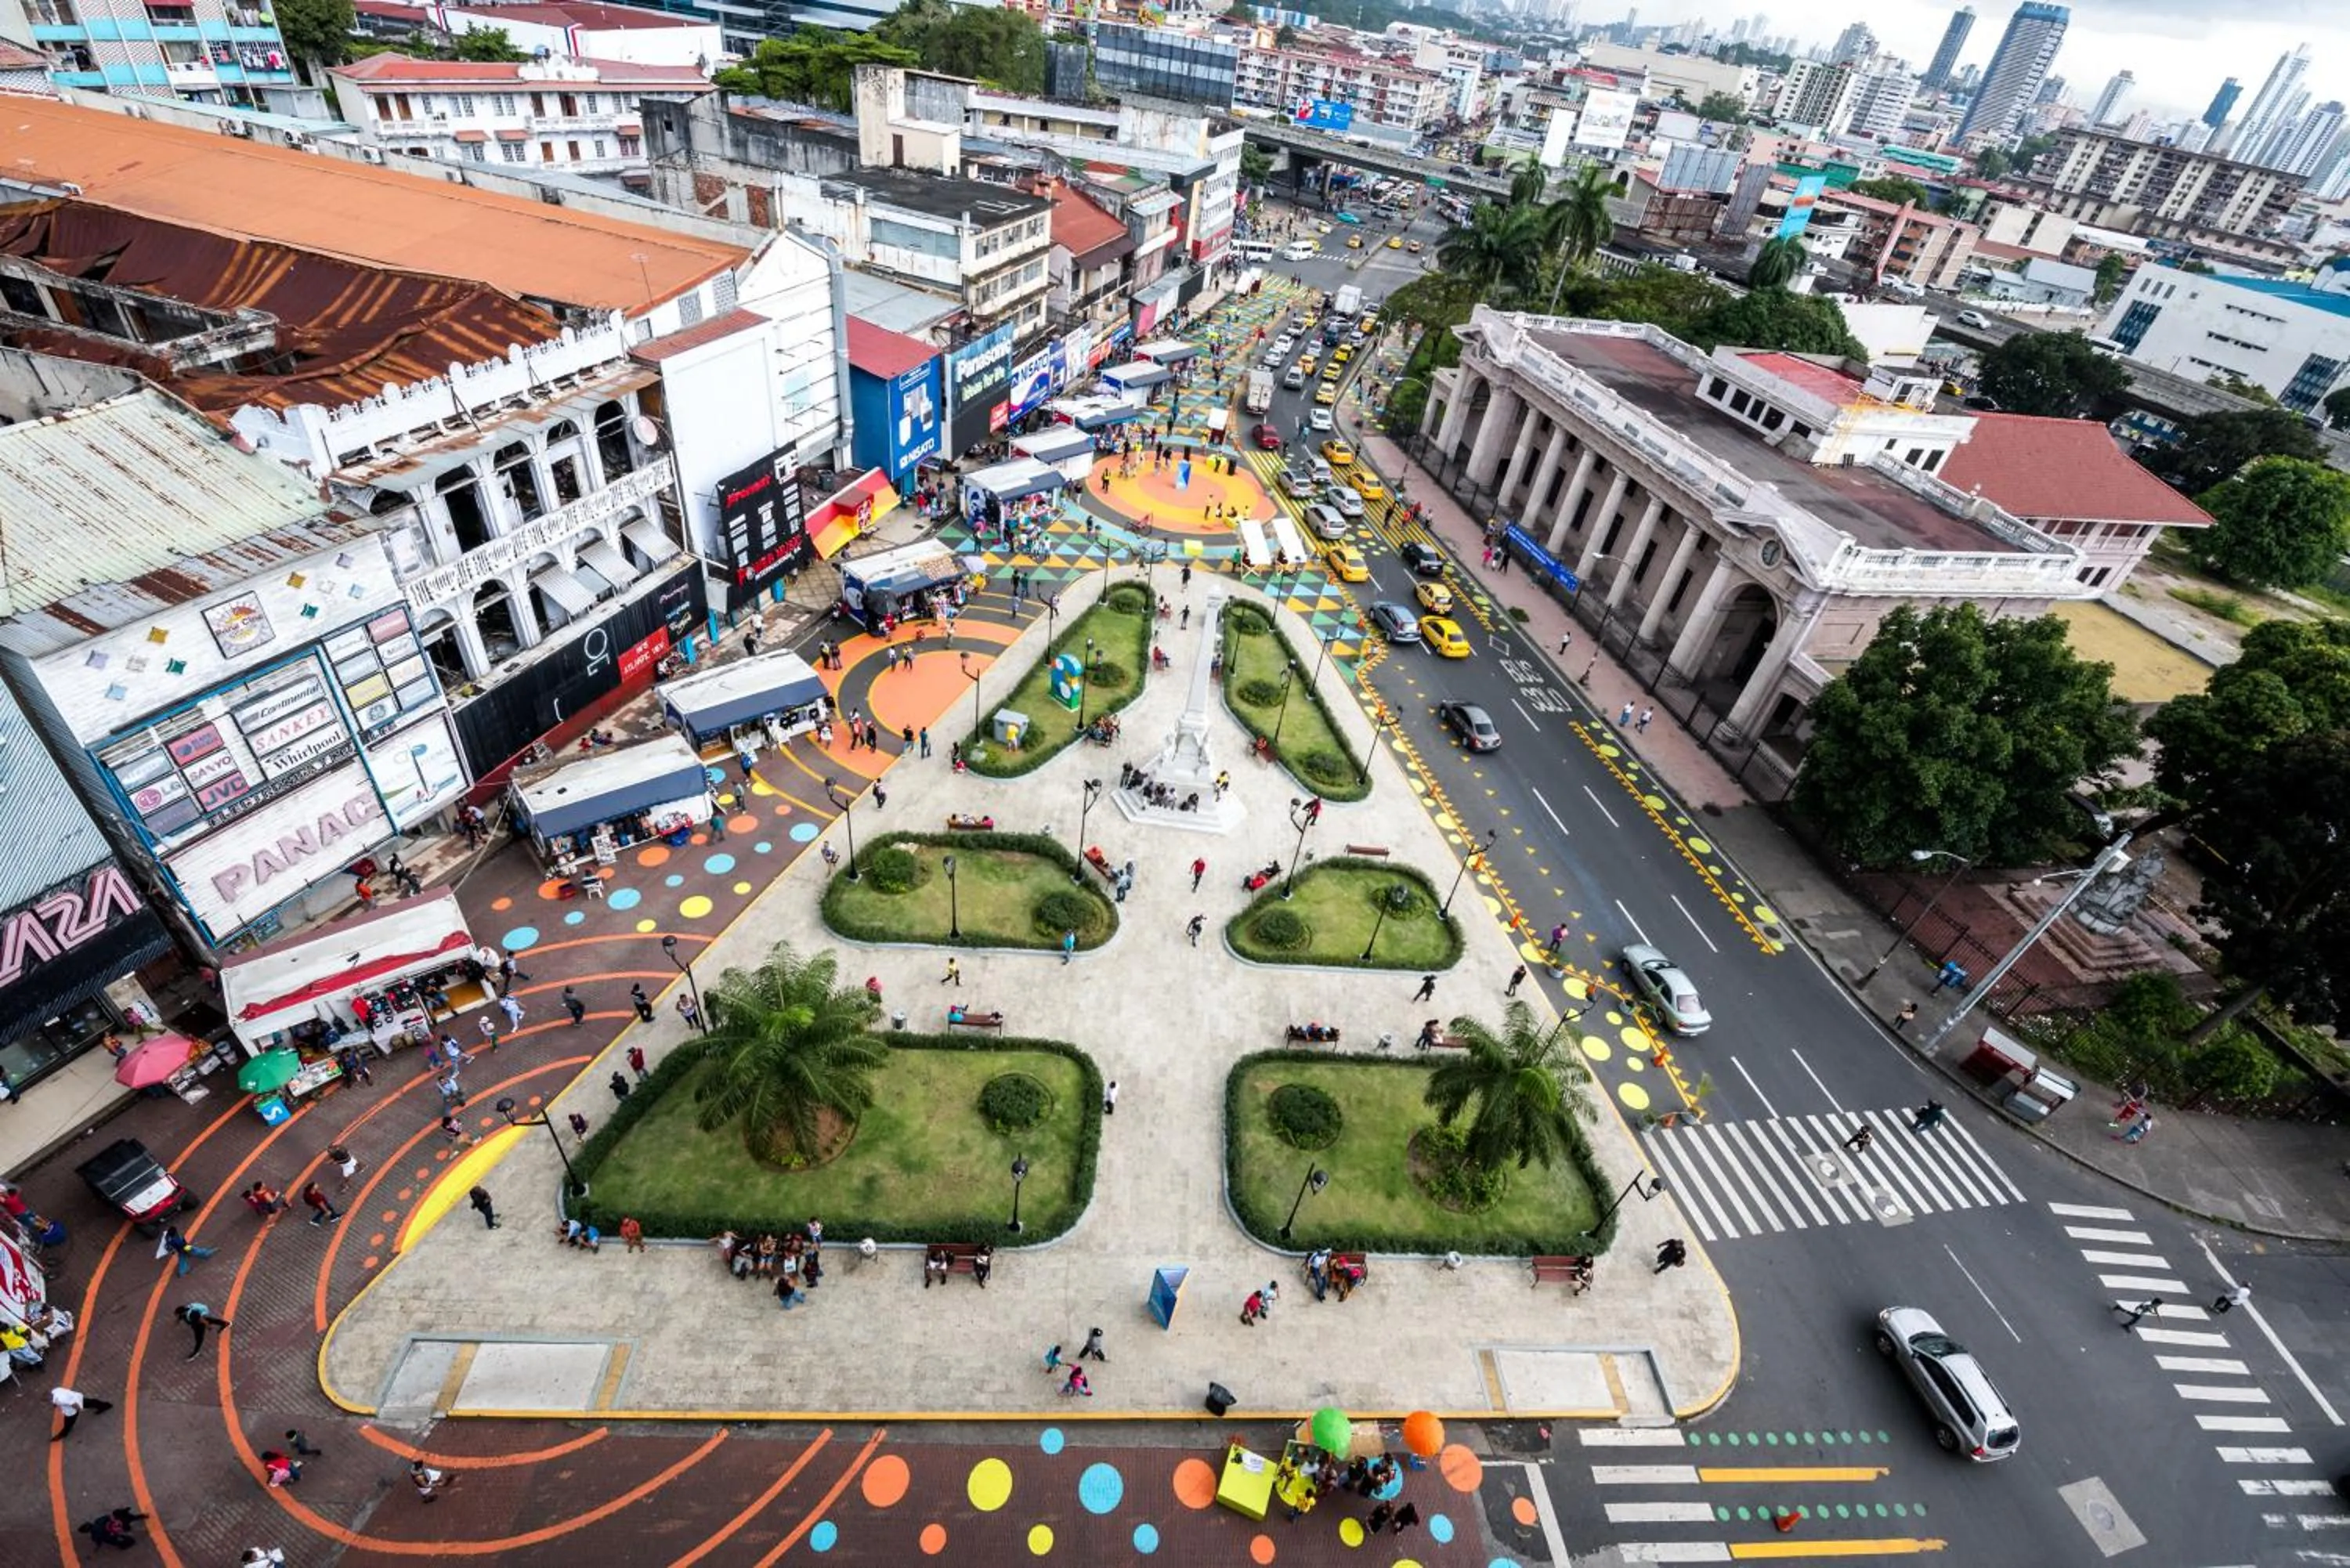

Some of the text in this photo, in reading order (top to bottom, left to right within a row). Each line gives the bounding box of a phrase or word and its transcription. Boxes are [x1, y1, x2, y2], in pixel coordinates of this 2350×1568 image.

[956, 338, 1011, 382] Panasonic
[1020, 353, 1048, 381] NISATO
[1499, 659, 1544, 684] BUS
[260, 682, 320, 718] Continental
[1520, 687, 1572, 712] SOLO
[255, 705, 328, 751] SANKEY
[273, 730, 342, 771] Whirlpool
[190, 755, 232, 782] SANYO
[161, 781, 182, 796] LG
[205, 775, 249, 806] JVC
[211, 791, 380, 903] PANAC
